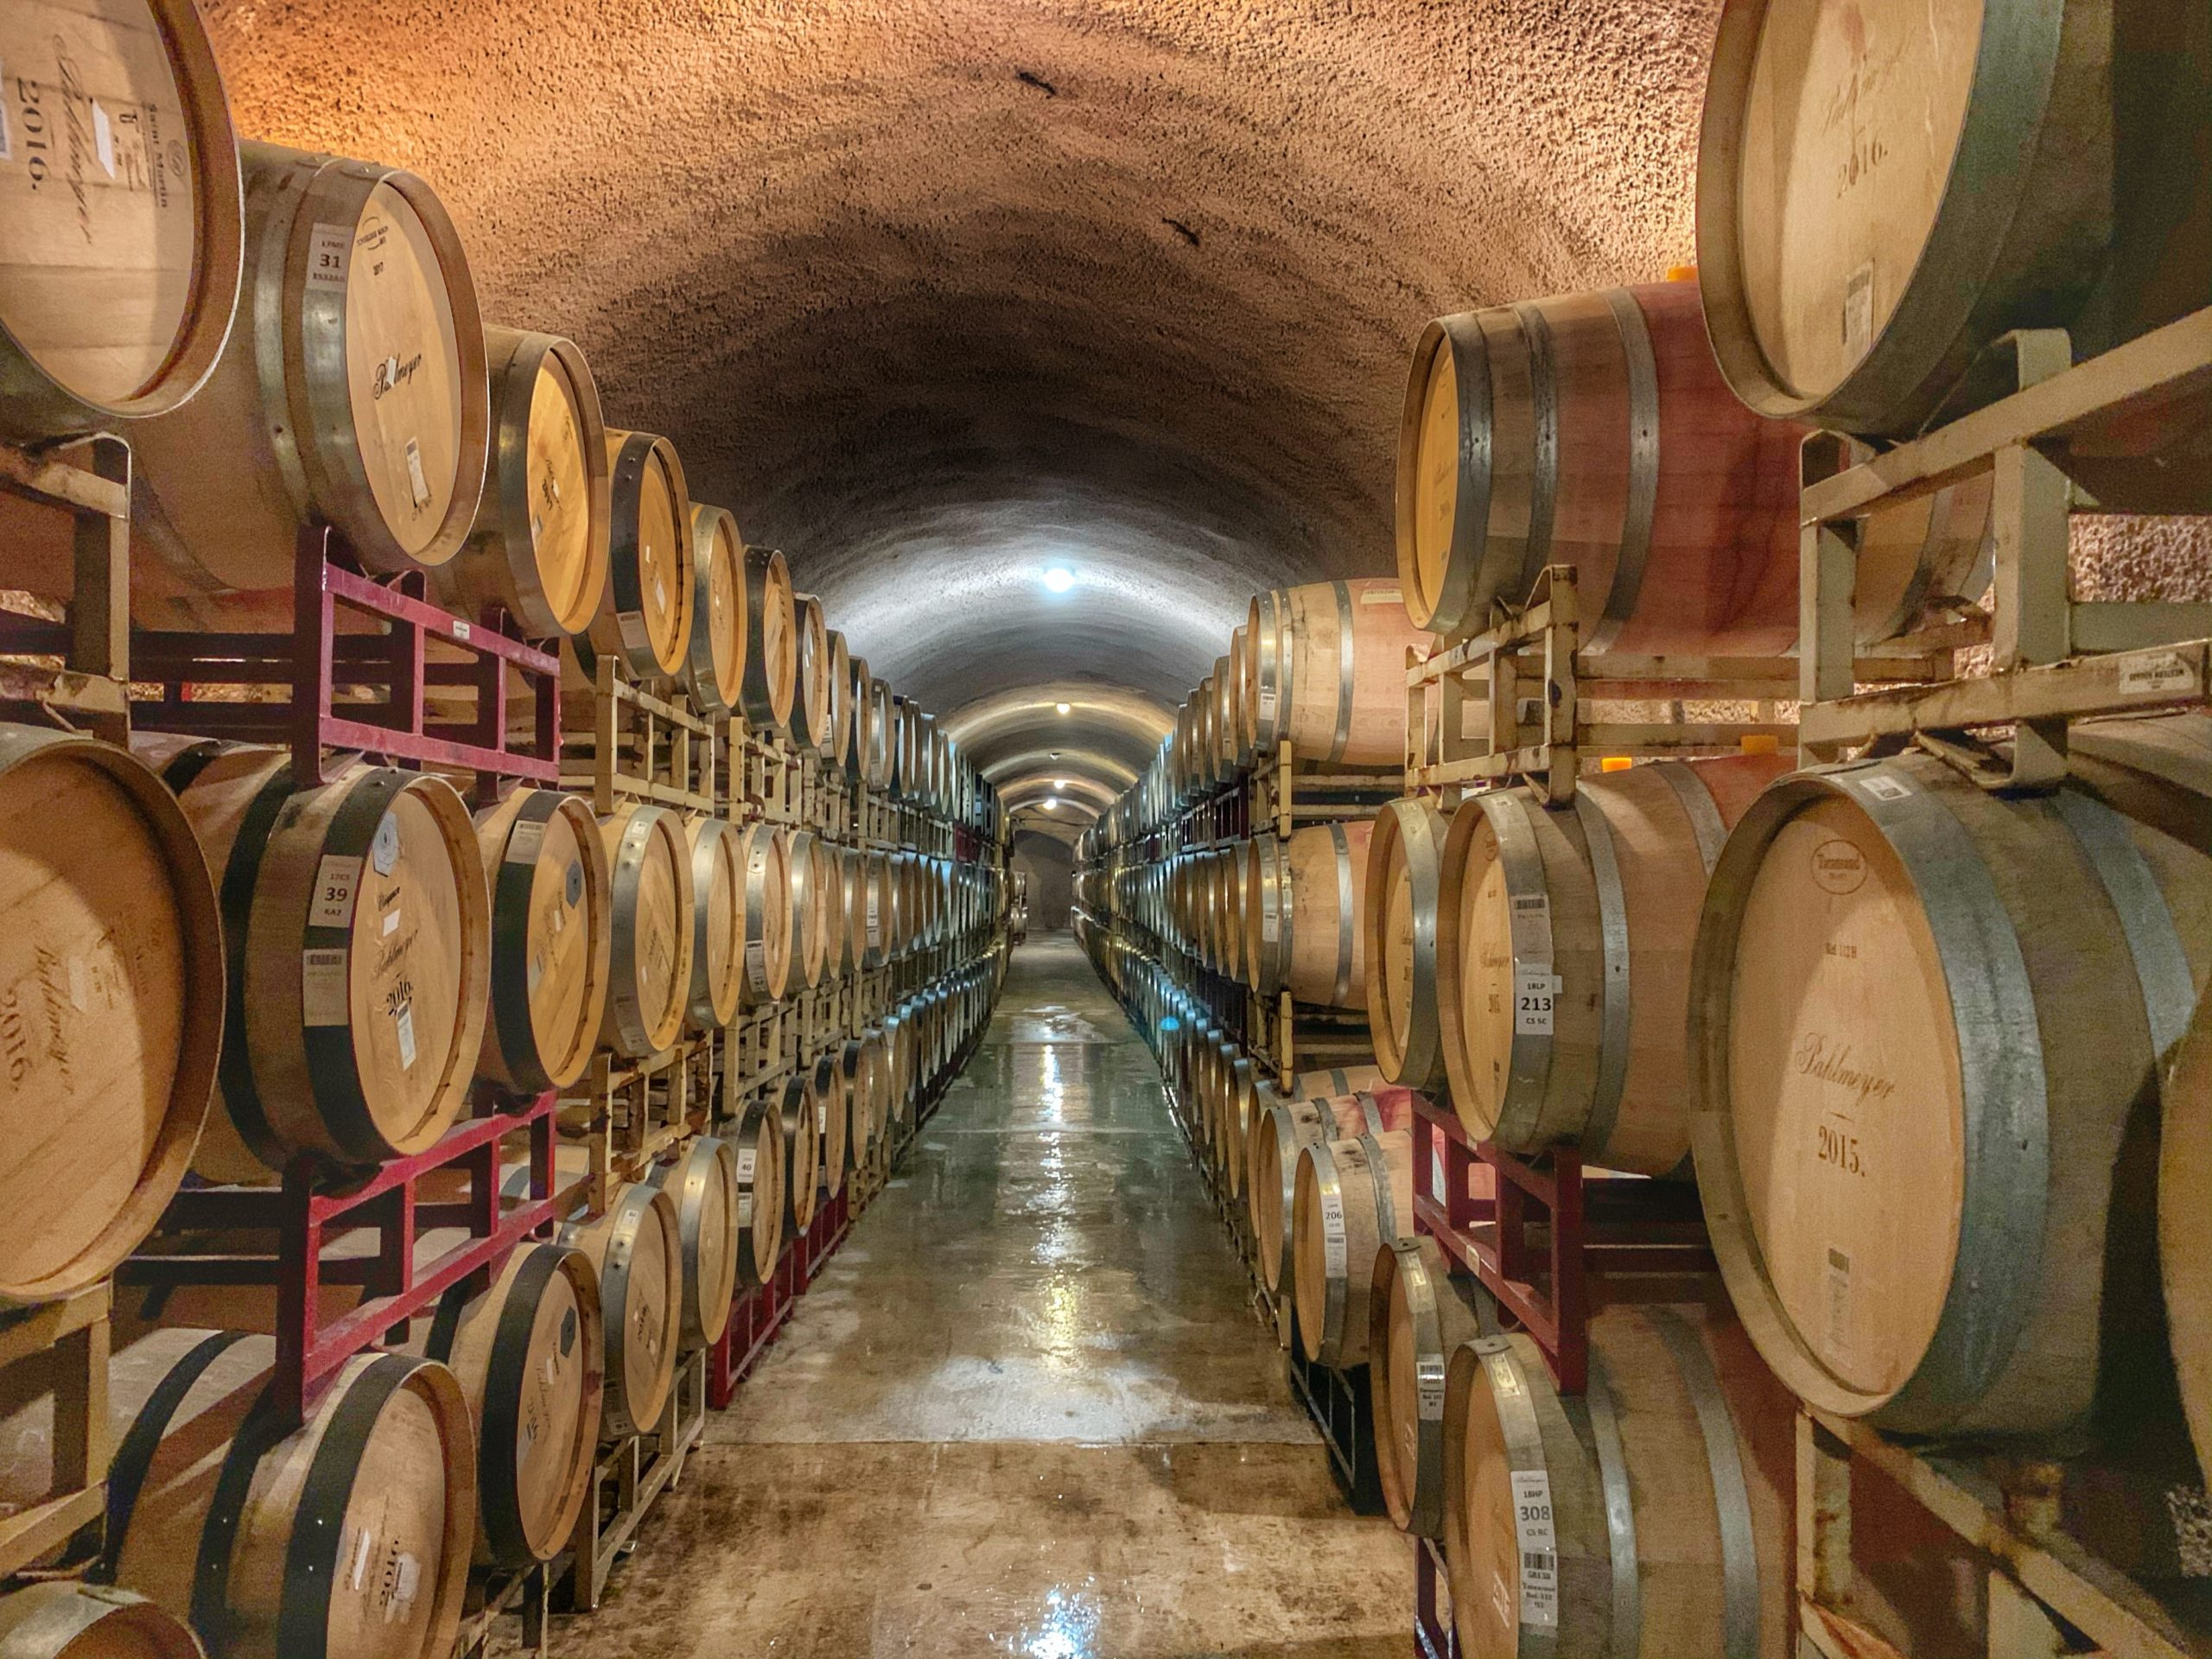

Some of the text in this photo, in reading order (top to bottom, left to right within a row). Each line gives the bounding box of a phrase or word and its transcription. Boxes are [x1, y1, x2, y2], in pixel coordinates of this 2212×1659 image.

[17, 76, 51, 191] 2016.
[320, 253, 341, 269] 31
[373, 353, 423, 400] Palmeyer
[324, 887, 348, 902] 39
[1521, 996, 1552, 1012] 213
[1795, 1032, 1896, 1107] Pahlmeyer
[1818, 1125, 1866, 1178] 2015.
[741, 1163, 752, 1172] 40
[1325, 1211, 1343, 1220] 206
[1520, 1505, 1551, 1522] 308
[1526, 1528, 1536, 1536] CS
